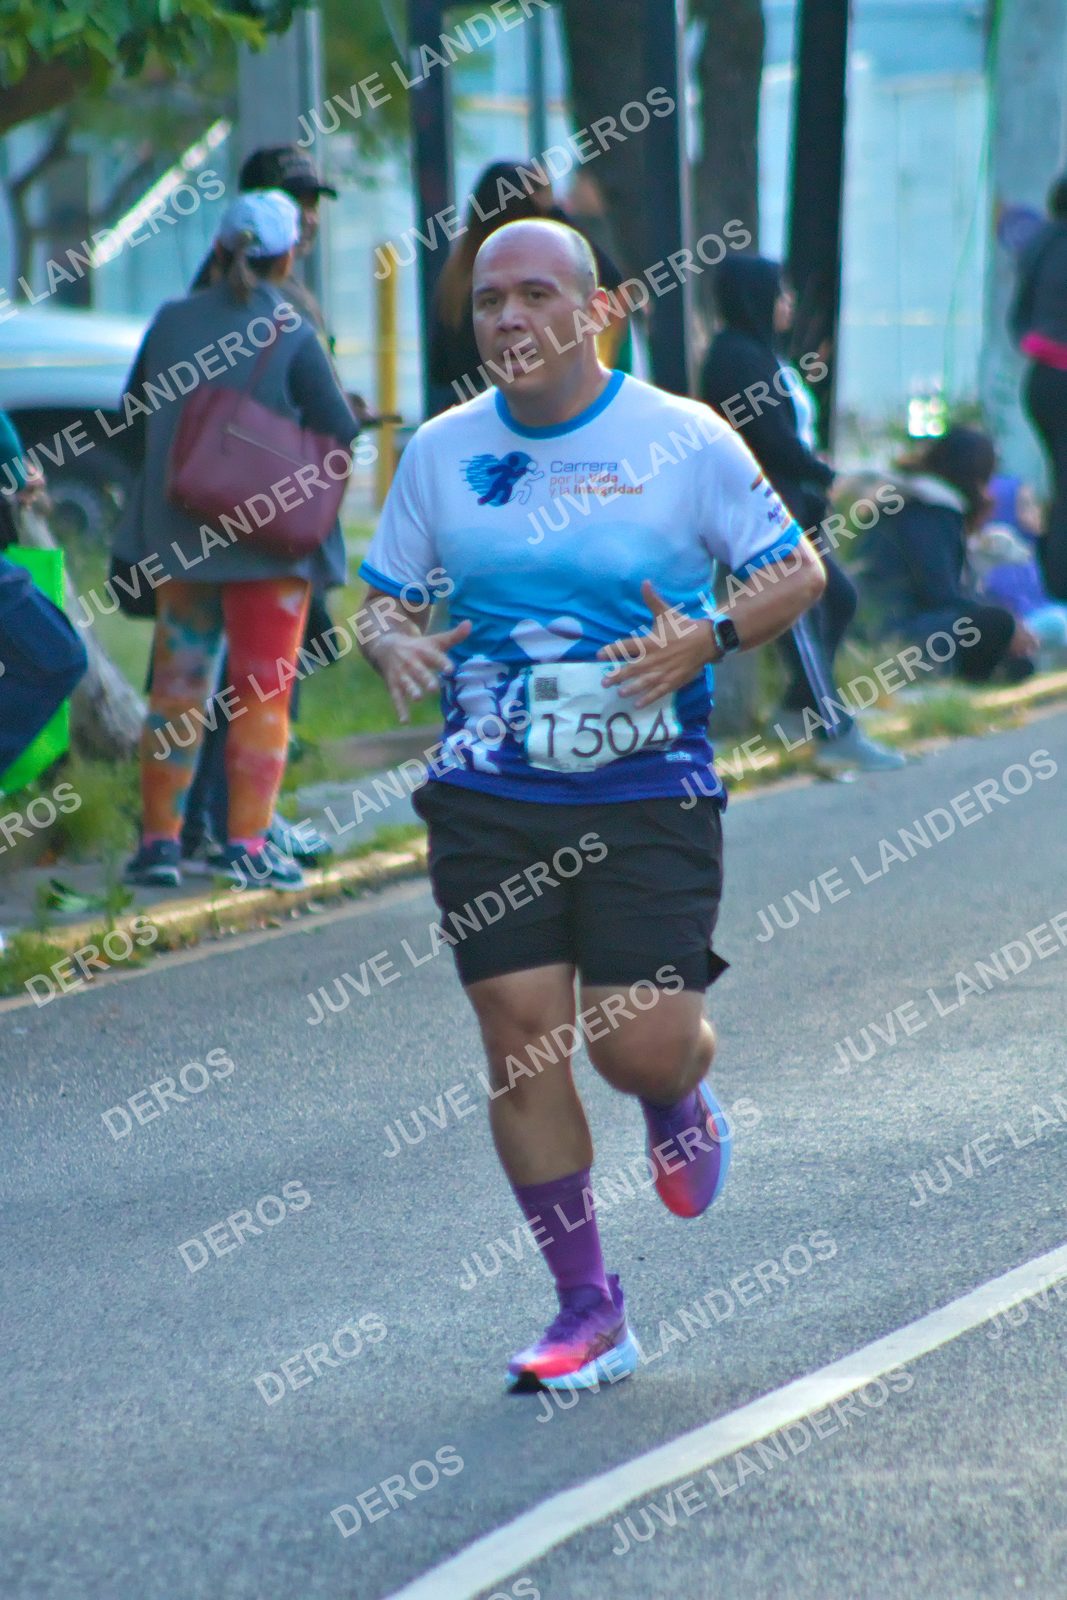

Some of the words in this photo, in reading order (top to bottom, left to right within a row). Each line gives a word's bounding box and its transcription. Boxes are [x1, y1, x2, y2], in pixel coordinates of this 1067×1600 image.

[550, 460, 618, 473] Carrera
[549, 474, 572, 486] por
[589, 473, 619, 483] Vida
[574, 484, 643, 497] Integridad
[541, 708, 673, 758] 1504
